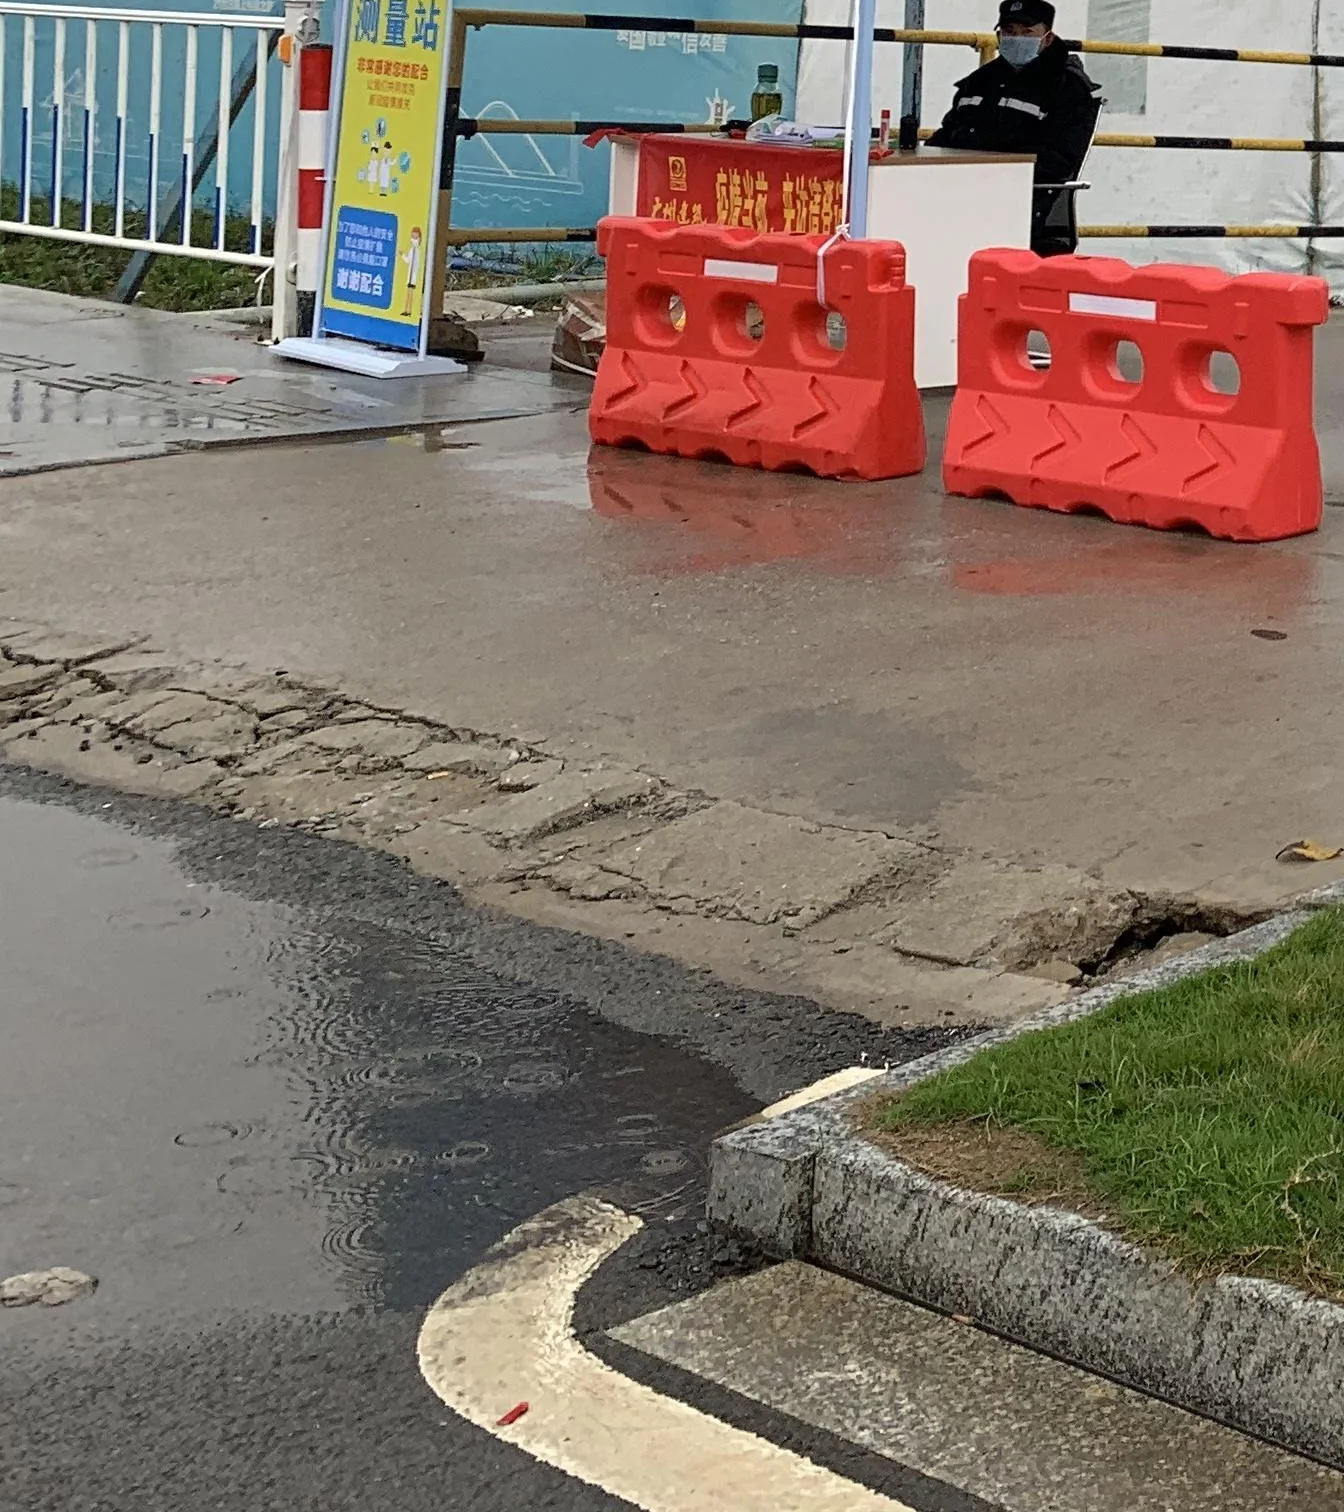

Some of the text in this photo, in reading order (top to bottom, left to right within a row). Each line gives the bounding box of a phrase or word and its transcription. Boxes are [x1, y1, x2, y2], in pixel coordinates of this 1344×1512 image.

[356, 57, 429, 81] 非常感谢您的配合
[336, 267, 384, 297] 谢谢配合
